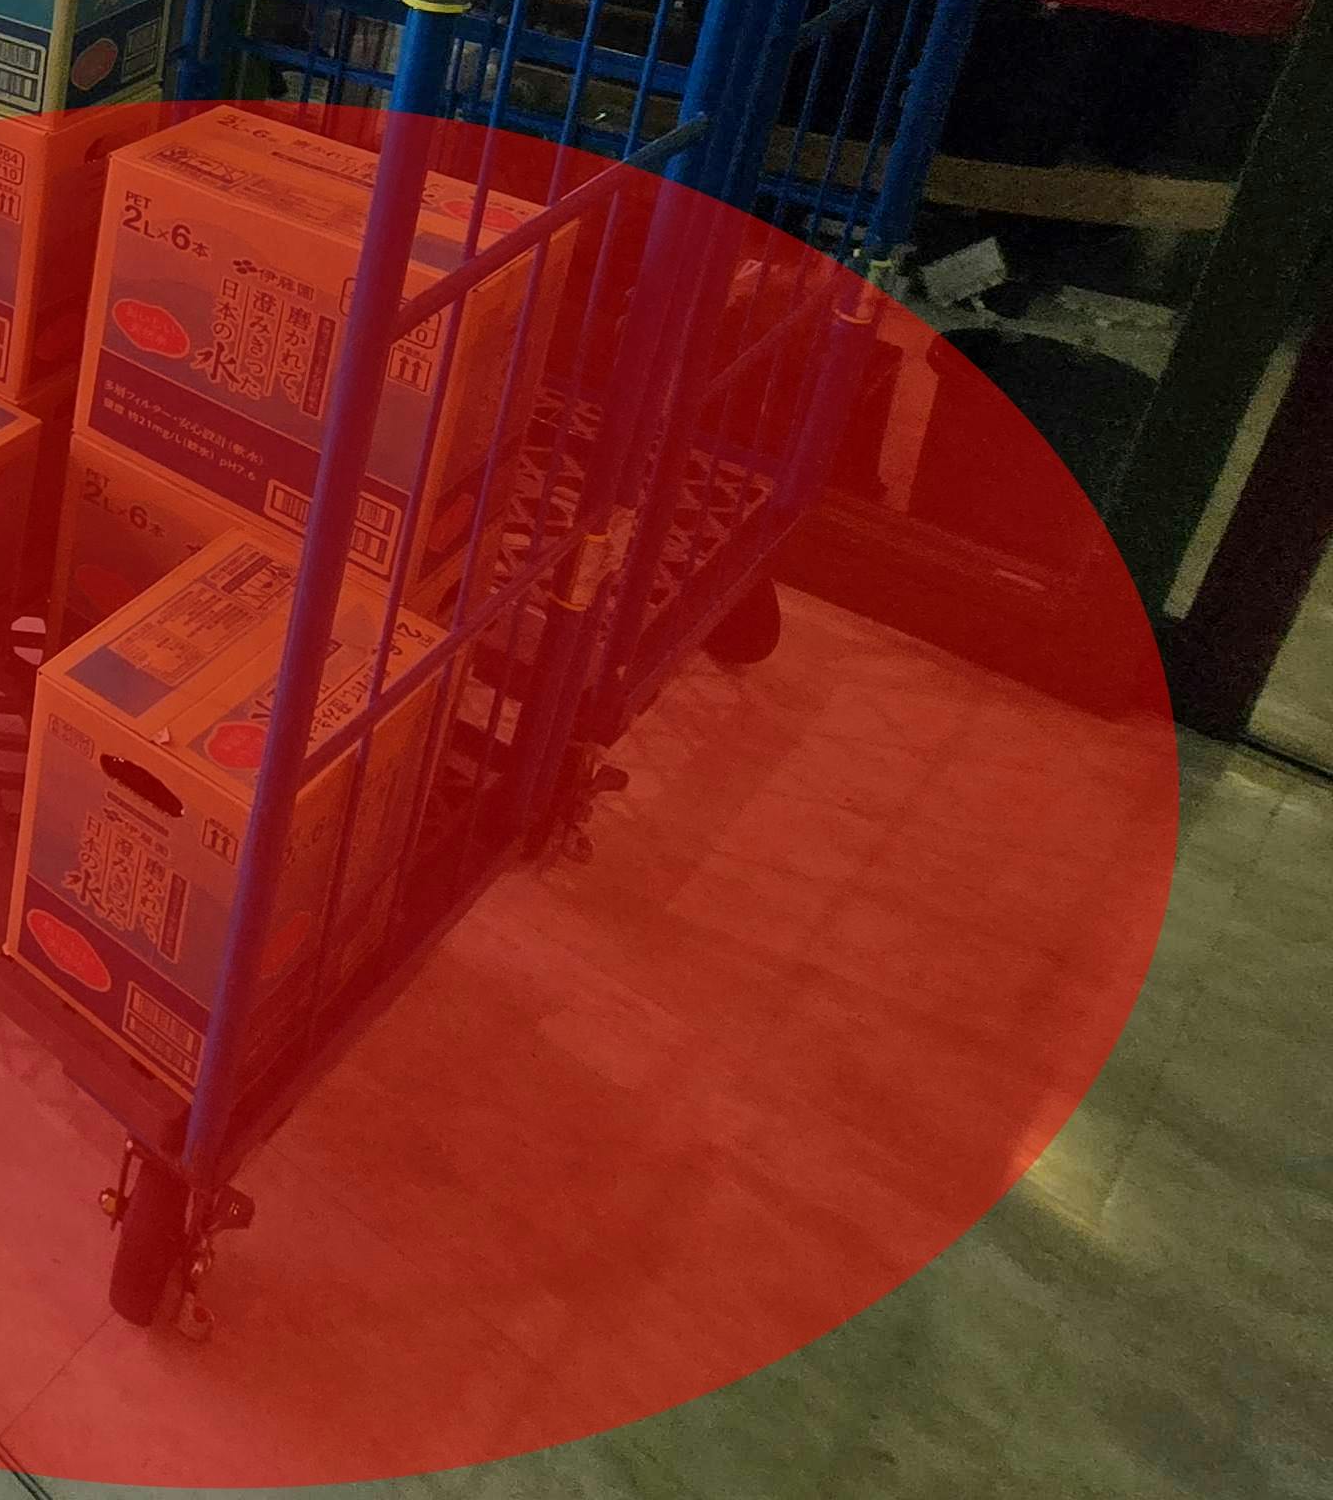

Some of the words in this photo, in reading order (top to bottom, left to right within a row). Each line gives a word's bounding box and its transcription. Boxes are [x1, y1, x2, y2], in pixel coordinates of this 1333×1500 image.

[125, 189, 153, 210] PET
[196, 277, 241, 383] 日本の水
